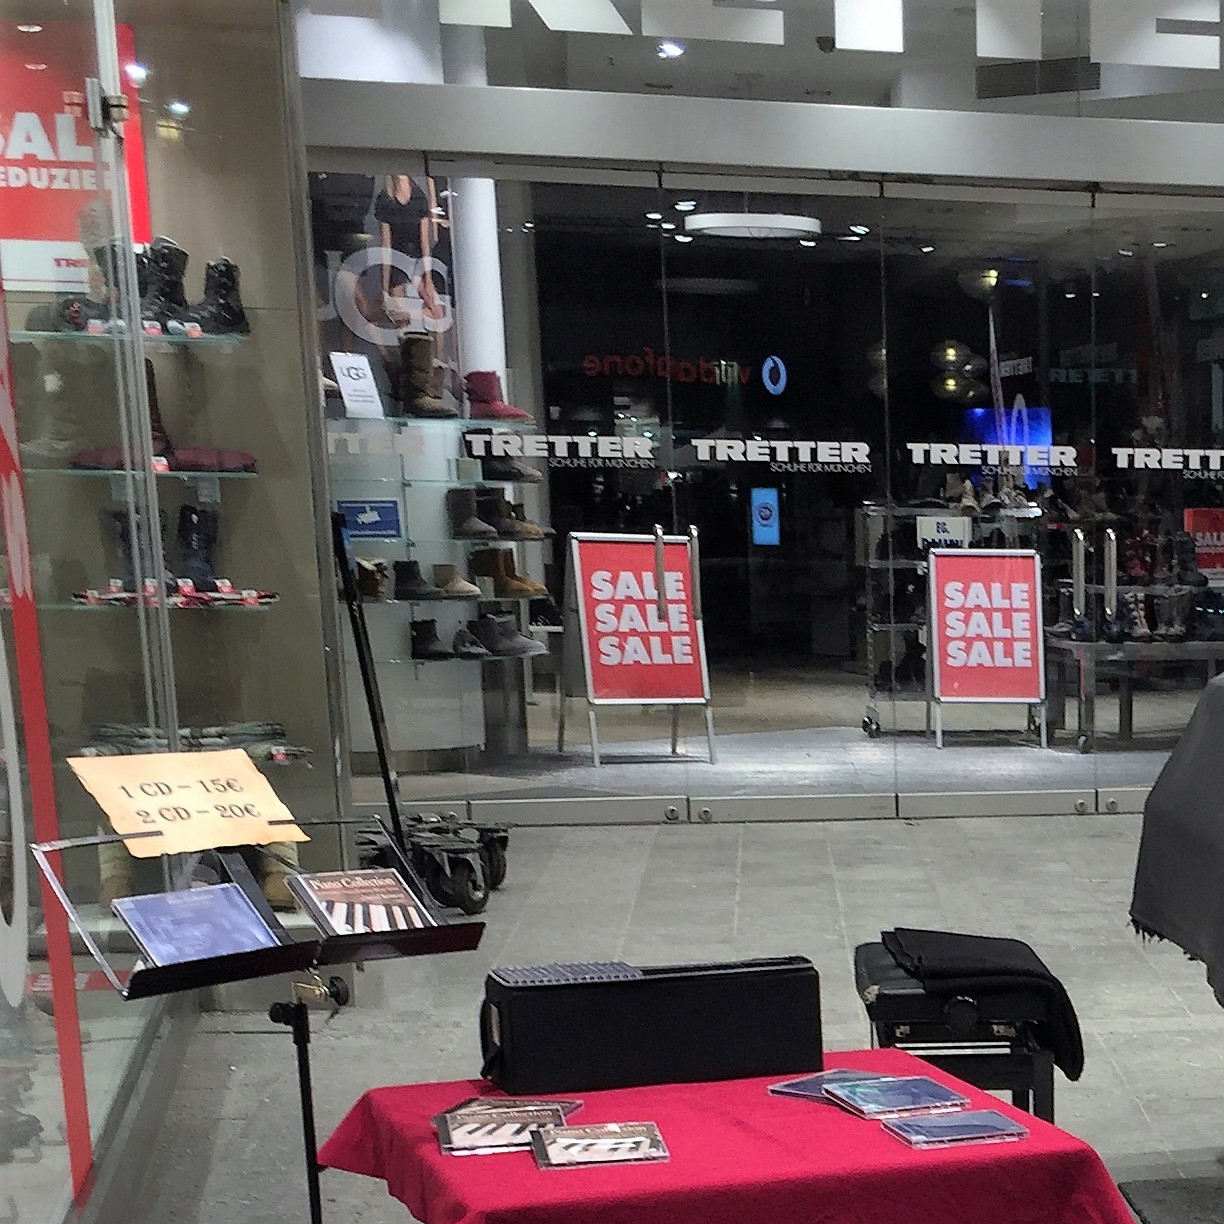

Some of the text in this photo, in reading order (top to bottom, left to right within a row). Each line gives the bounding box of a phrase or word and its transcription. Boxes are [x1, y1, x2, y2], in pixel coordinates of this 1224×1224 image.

[465, 433, 655, 459] TRETTER
[690, 438, 871, 464] TRETTER
[905, 442, 1078, 468] TRETTER
[590, 570, 686, 600] SALE
[943, 581, 1030, 609] SALE
[594, 603, 690, 633] SALE
[944, 610, 1032, 639] SALE
[598, 635, 694, 666] SALE
[946, 640, 1033, 668] SALE
[119, 784, 135, 799] 1
[139, 781, 173, 797] CD
[196, 777, 244, 794] 15€
[135, 809, 156, 824] 2
[157, 806, 192, 822] CD
[213, 803, 262, 819] 20€
